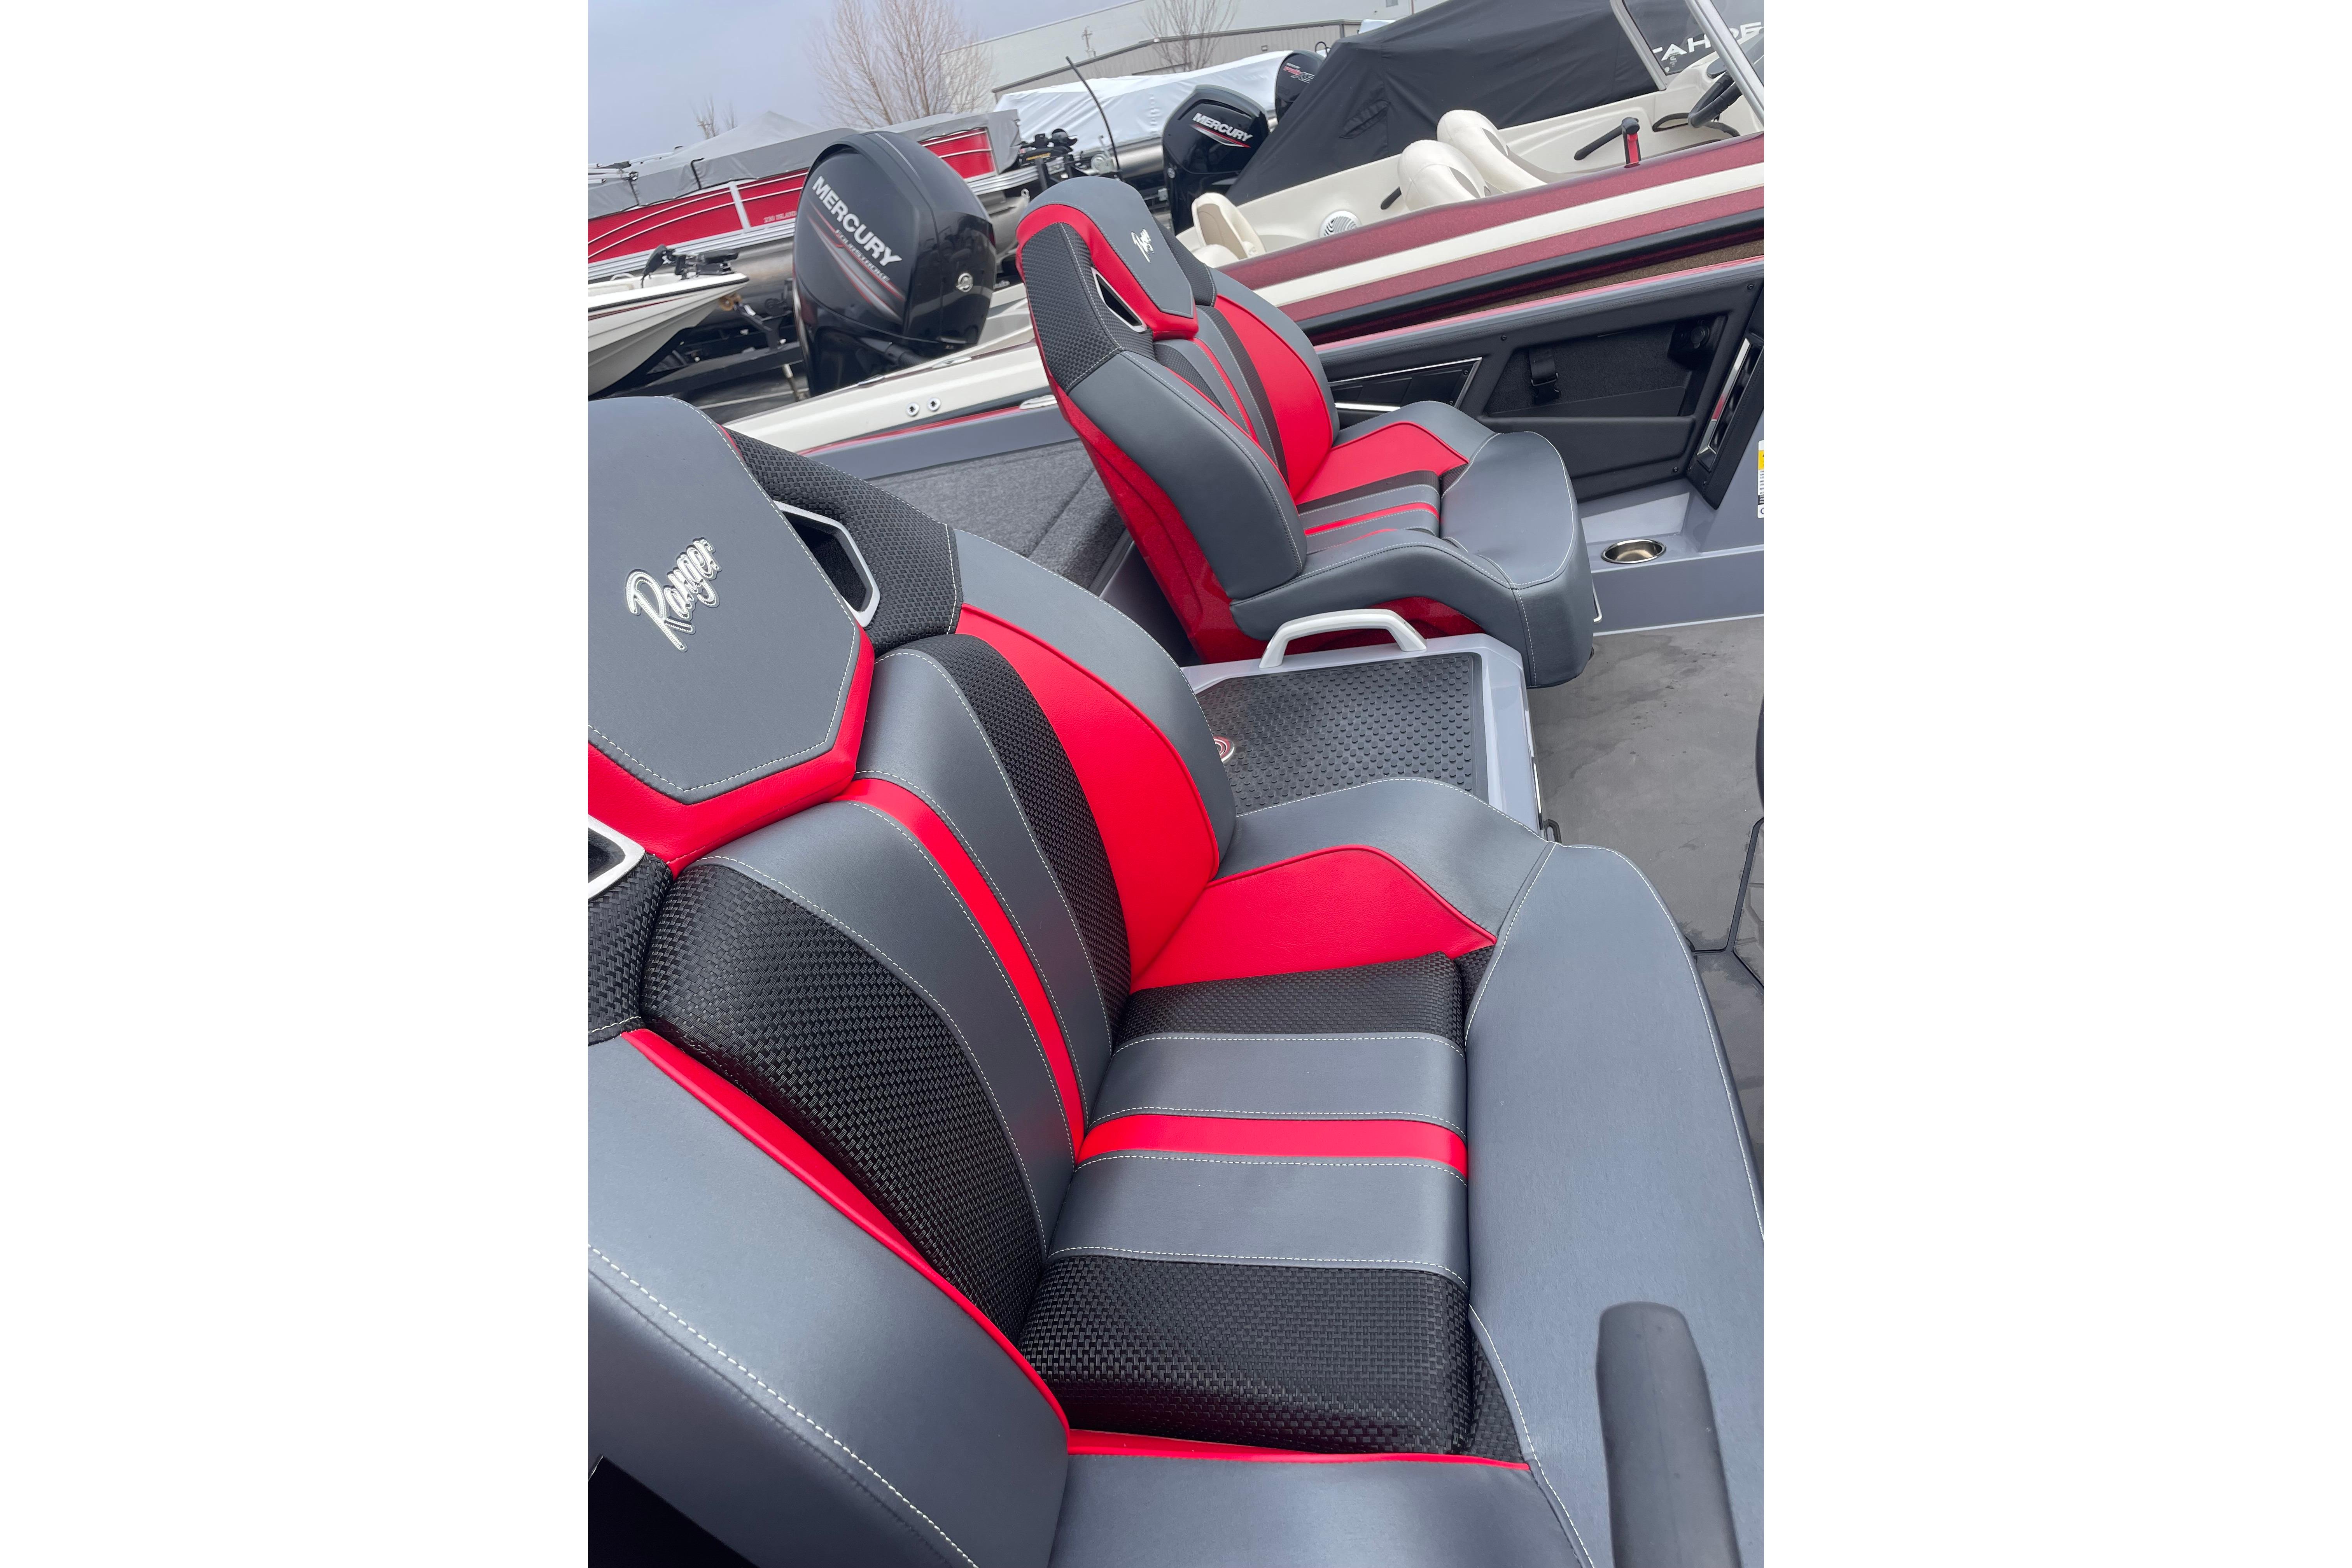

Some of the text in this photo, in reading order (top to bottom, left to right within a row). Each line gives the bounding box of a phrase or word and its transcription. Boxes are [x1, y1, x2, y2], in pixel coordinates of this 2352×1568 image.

[1652, 22, 1762, 61] AHE
[1192, 113, 1253, 142] MERCURY
[812, 176, 903, 267] MERCURY
[625, 537, 722, 652] Ranger
